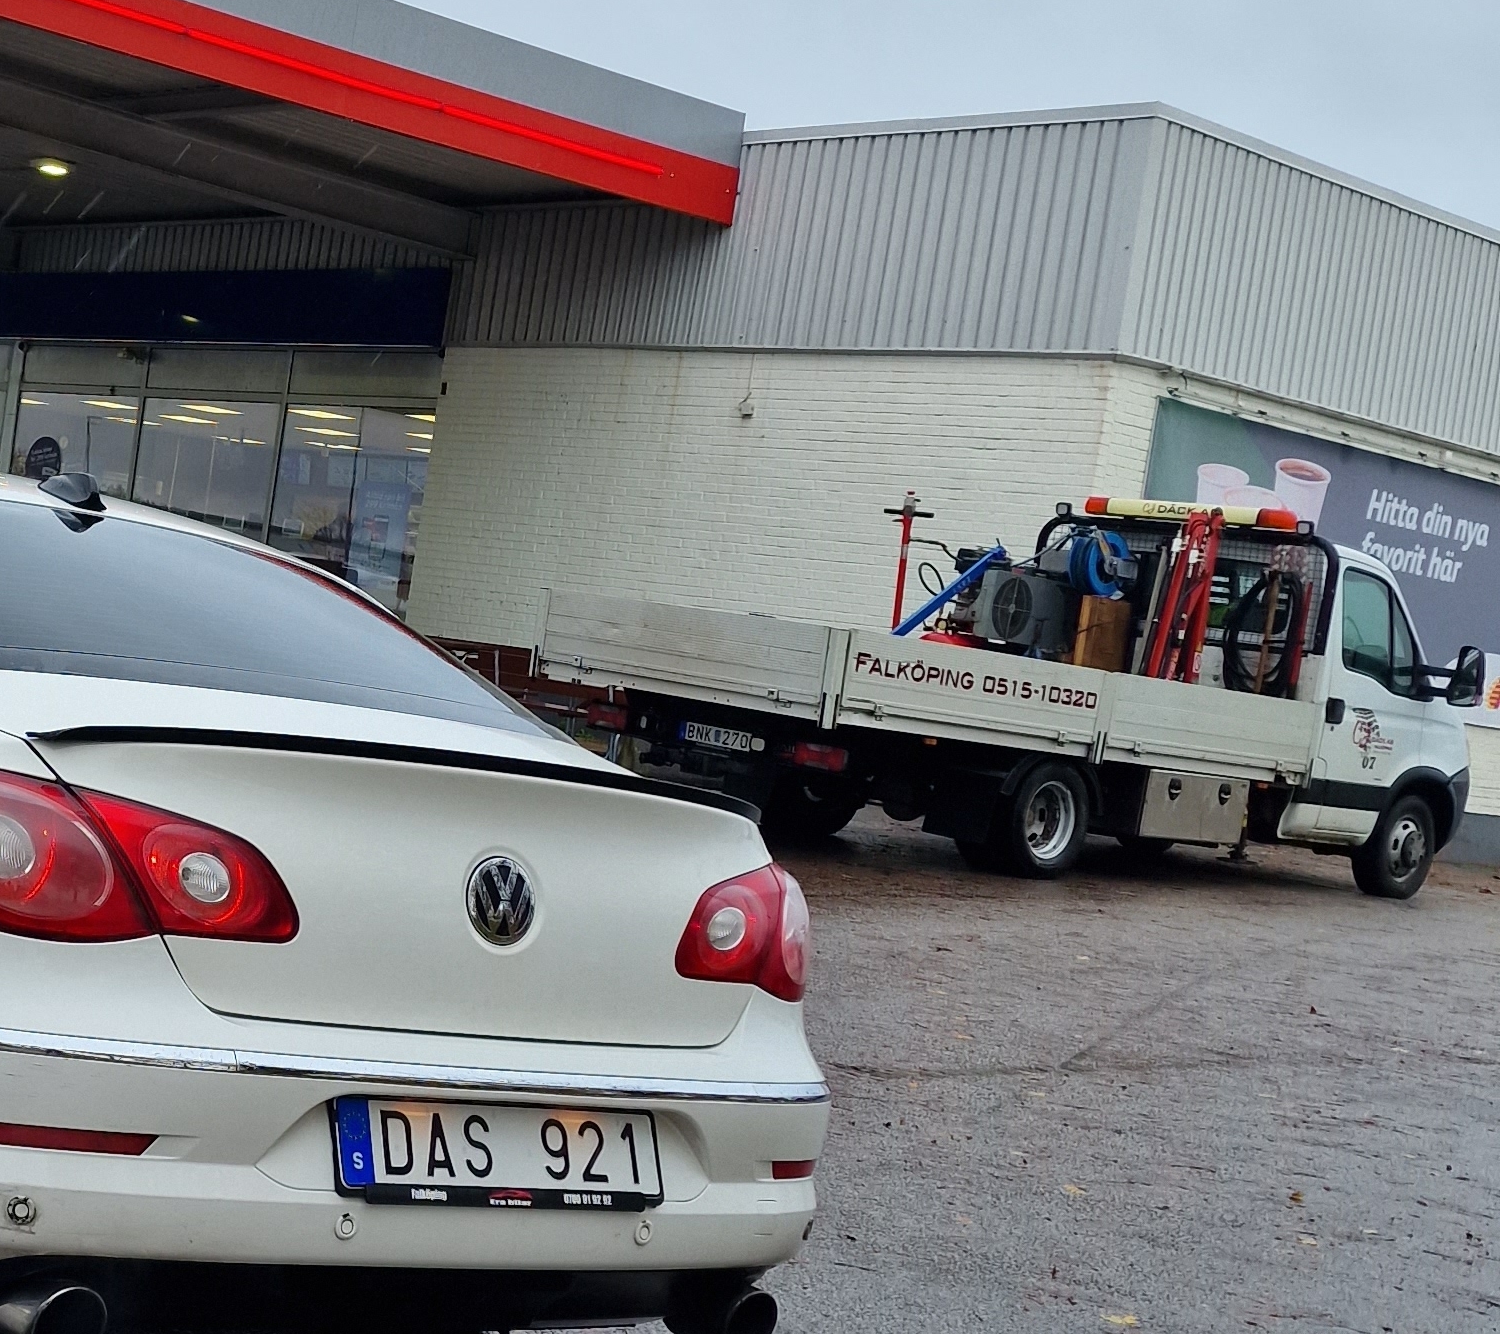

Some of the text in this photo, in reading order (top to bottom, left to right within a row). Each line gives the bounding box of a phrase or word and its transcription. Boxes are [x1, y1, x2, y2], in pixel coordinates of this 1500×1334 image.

[1366, 488, 1490, 552] Hitta din nya
[1426, 546, 1463, 583] här
[854, 652, 1098, 709] FALKÖPING 0515-10320
[687, 723, 749, 749] BNK 270
[1361, 756, 1377, 770] 07
[352, 1109, 641, 1185] S DAS 921
